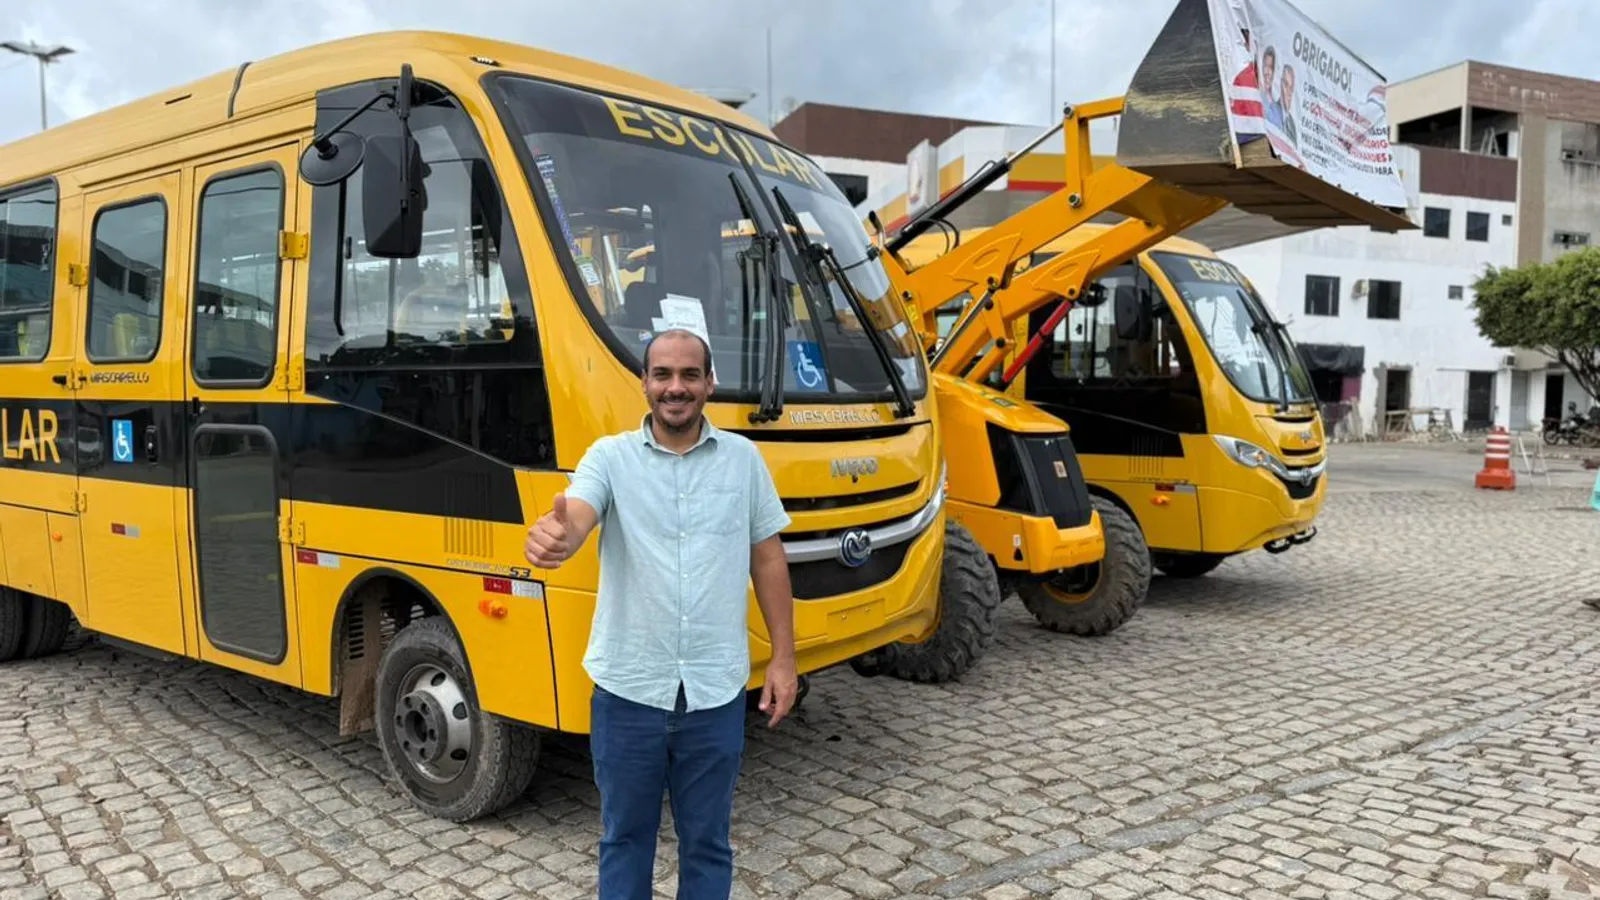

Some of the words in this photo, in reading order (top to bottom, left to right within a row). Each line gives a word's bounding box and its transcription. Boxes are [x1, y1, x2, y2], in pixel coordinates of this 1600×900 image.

[1293, 31, 1352, 94] OBRIGADO!
[602, 98, 824, 190] ESCOLAR
[1, 407, 61, 464] LAR
[789, 409, 880, 425] MASCARELLO
